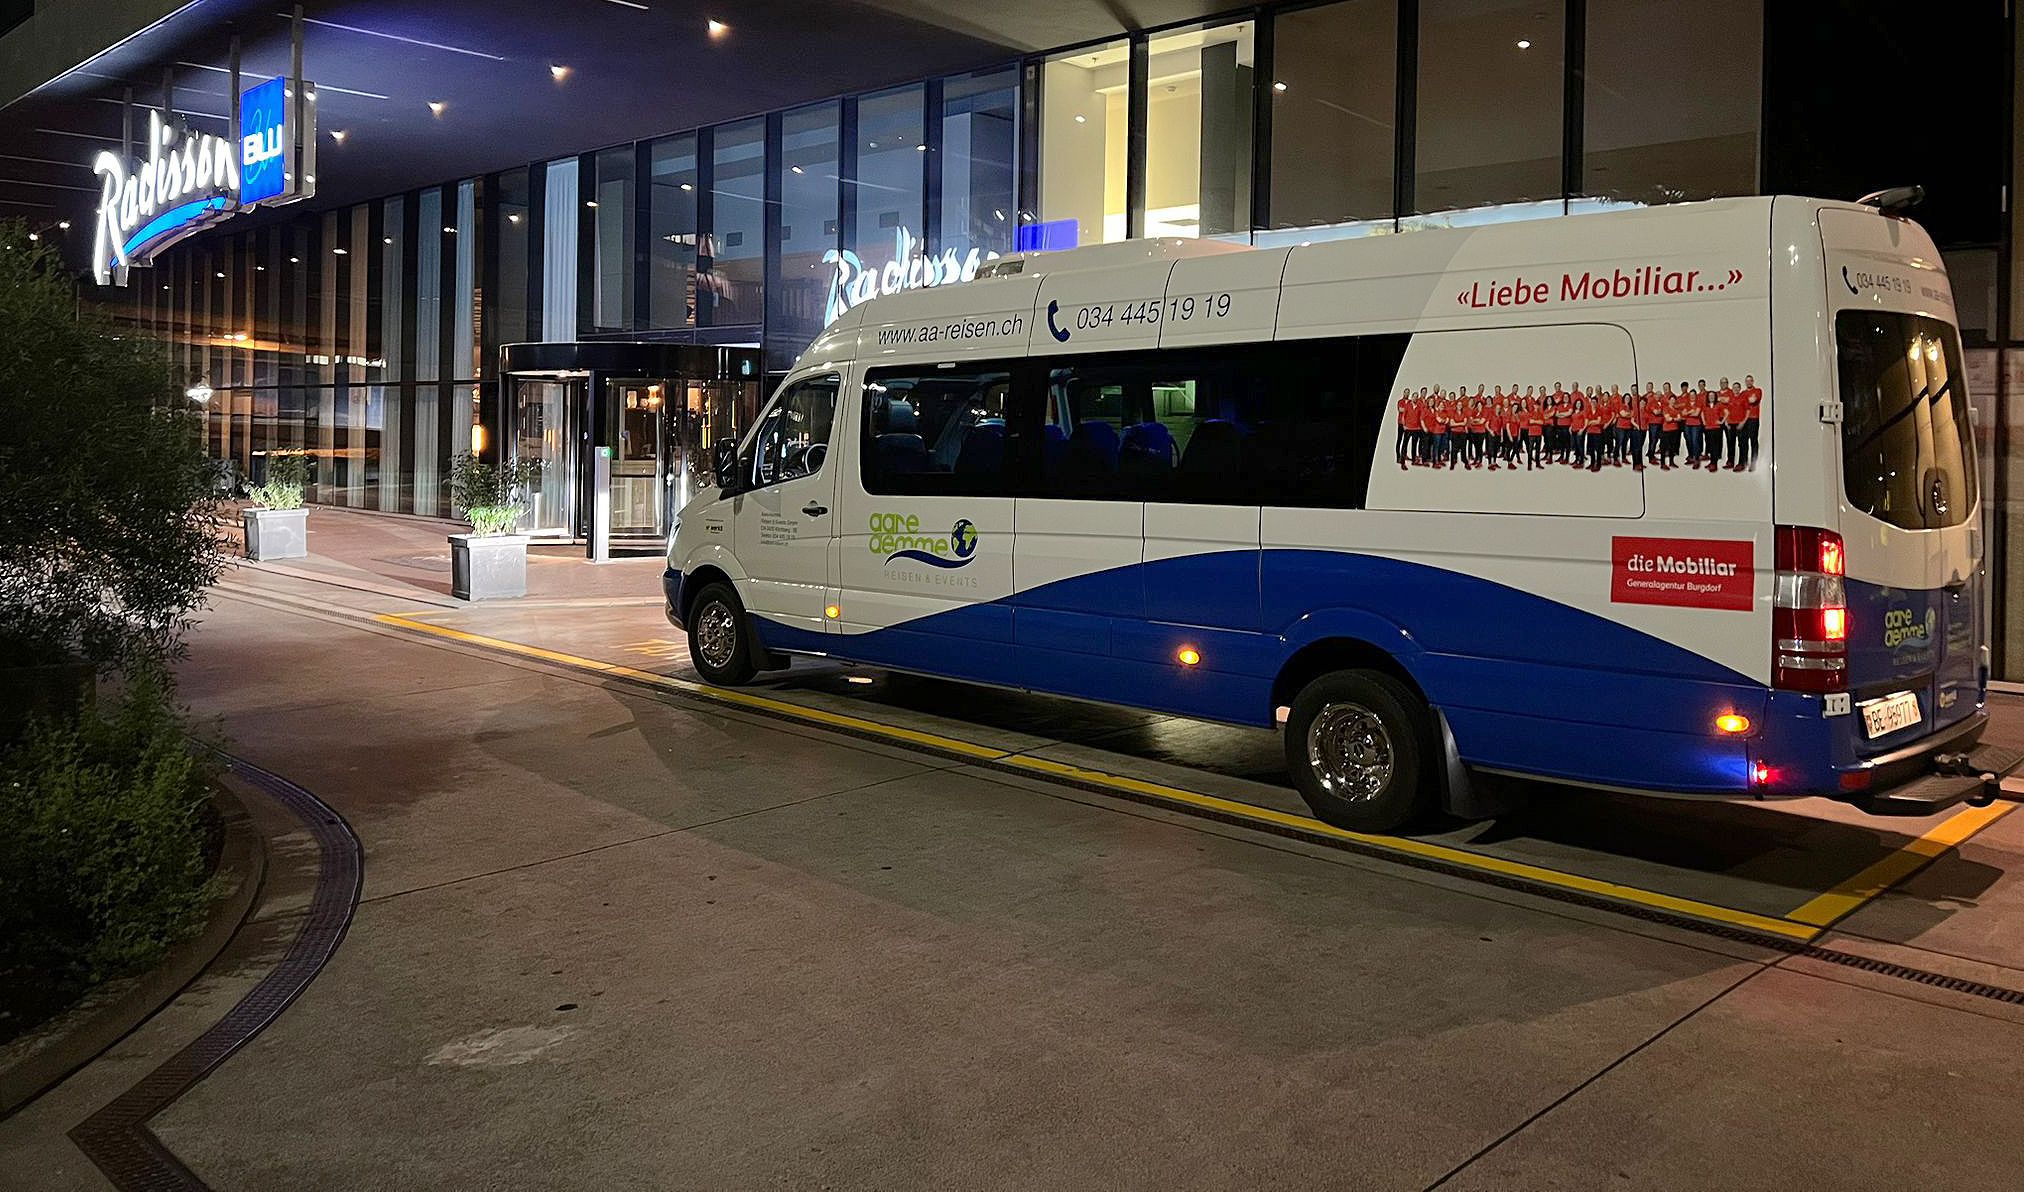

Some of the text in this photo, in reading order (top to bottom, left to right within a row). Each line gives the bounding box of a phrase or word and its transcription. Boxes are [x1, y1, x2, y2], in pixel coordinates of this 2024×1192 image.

[93, 109, 283, 285] Radisson BLU
[1457, 277, 1549, 308] «Liebe
[1857, 272, 1873, 289] 034
[1076, 293, 1232, 330] 034 445 19 19
[878, 313, 1022, 345] www.aa-reisen.ch
[1627, 554, 1737, 577] die Mobiliar
[935, 574, 977, 588] EVENTS
[1627, 578, 1722, 594] Generalagentur Burgdorf
